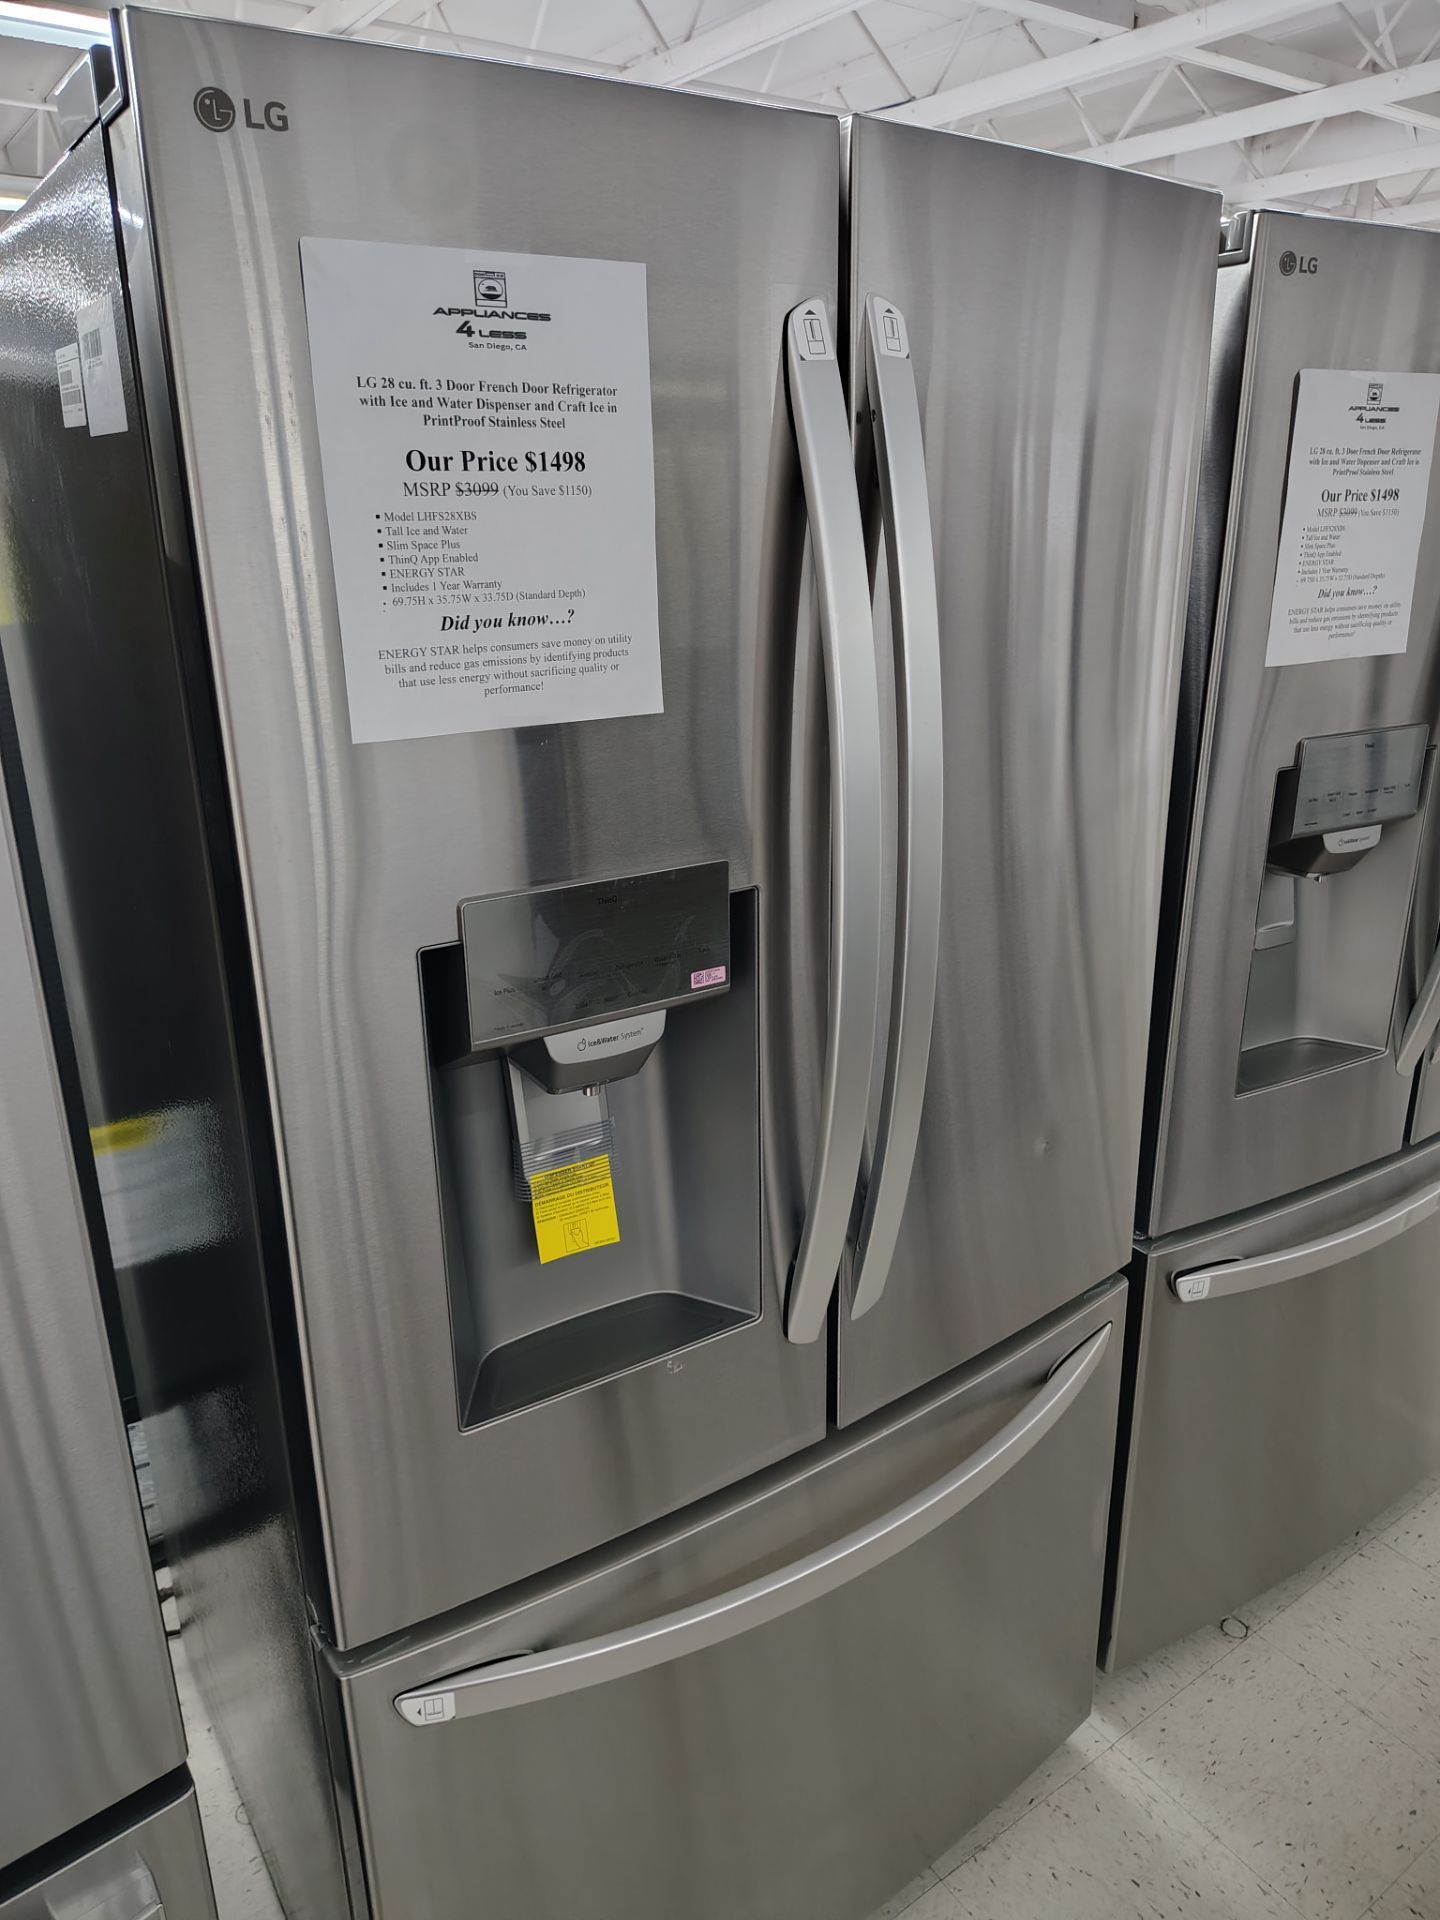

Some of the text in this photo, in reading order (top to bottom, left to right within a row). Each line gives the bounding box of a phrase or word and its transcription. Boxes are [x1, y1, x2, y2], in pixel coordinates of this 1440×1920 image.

[243, 98, 289, 132] LG
[1299, 256, 1318, 274] LG
[433, 307, 551, 322] APPLIANCES
[456, 320, 527, 340] 4 LESS
[486, 342, 513, 351] Diego,
[357, 376, 618, 398] LG 28 cu. ft. 3 Door French Door Refrigerator
[359, 394, 617, 413] with Ice and Water Dispenser and Craft Ice in
[423, 414, 566, 429] PrintProof Stainless Steel
[406, 449, 585, 473] Our Price $1498
[403, 481, 592, 499] MSRP $3099 (You Save $1150)
[1321, 488, 1400, 502] Our Price $1498
[384, 512, 414, 522] Model
[384, 525, 468, 536] Tall Ice and Water
[386, 539, 461, 553] Slim Space Plus
[387, 552, 479, 566] ThinQ App Enabled
[389, 567, 465, 579] ENERGY STAR
[391, 580, 502, 593] Includes 1 Year Warranty
[1318, 588, 1331, 599] Did
[1331, 590, 1345, 600] you
[392, 596, 426, 607] 69.75H
[436, 593, 472, 605] 35.75W
[481, 592, 514, 603] 33.75D
[515, 589, 556, 602] (Standard
[558, 588, 586, 600] Depth)
[440, 615, 470, 631] Did
[472, 618, 502, 633] you
[378, 633, 632, 660] ENERGY STAR helps consumers save money on utility
[384, 648, 629, 675] bills and reduce gas emissions by identifying products
[398, 678, 417, 688] that
[419, 678, 436, 687] use
[438, 675, 457, 685] less
[459, 674, 491, 684] energy
[493, 669, 529, 680] without
[530, 667, 577, 678] sacrificing
[578, 662, 608, 676] quality
[484, 681, 544, 698] performance!
